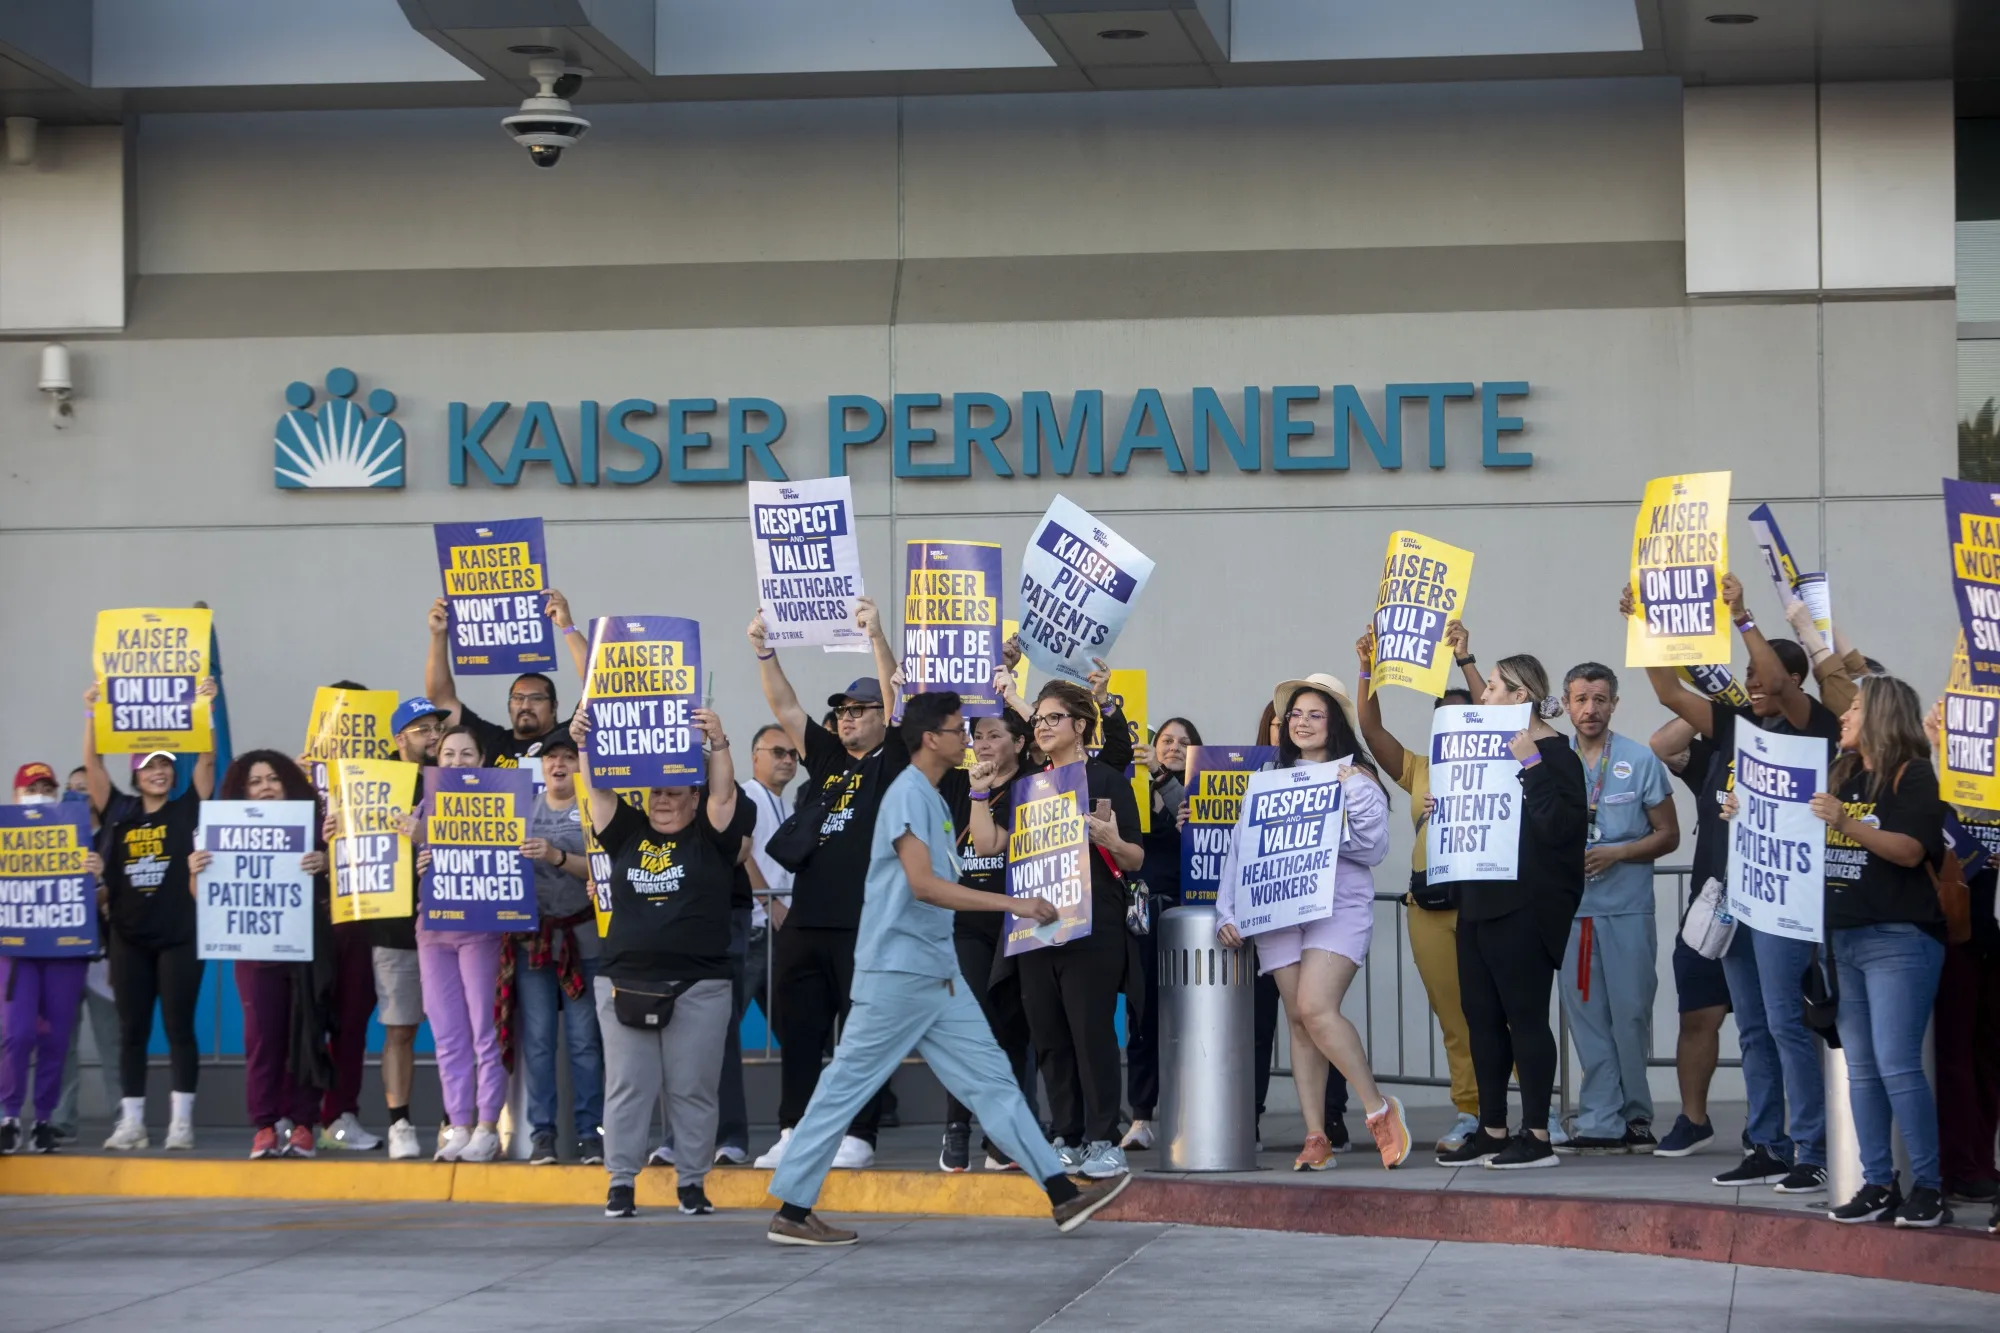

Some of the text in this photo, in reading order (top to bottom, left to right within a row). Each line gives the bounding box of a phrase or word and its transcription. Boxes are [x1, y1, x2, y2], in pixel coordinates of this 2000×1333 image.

[448, 381, 1534, 485] KAISER PERMANENTE
[758, 504, 838, 535] RESPECT
[1650, 501, 1708, 534] KAISER
[790, 535, 804, 543] AND
[1637, 531, 1719, 566] WORKERS
[458, 546, 521, 569] KAISER
[771, 543, 831, 571] VALUE
[1052, 532, 1119, 594] KAISER:
[451, 568, 535, 592] WORKERS
[761, 575, 855, 600] HEALTHCARE
[914, 573, 976, 597] KAISER
[1051, 566, 1096, 609] PUT
[1646, 567, 1708, 601] ON ULP
[1377, 578, 1457, 611] ORKERS
[452, 595, 540, 622] WON'T BE
[773, 599, 848, 622] WORKERS
[908, 597, 989, 622] WORKERS
[1020, 573, 1109, 647] PATIENTS
[1393, 606, 1436, 636] ULP
[1649, 601, 1713, 635] STRIKE
[117, 627, 188, 650] KAISER
[456, 620, 543, 647] SILENCED
[782, 631, 804, 640] STRIKE
[906, 629, 991, 656] WON'T BE
[1021, 609, 1081, 660] FIRST
[102, 650, 201, 674] WORKERS
[605, 645, 674, 669] KAISER
[905, 656, 991, 684] SILENCED
[114, 677, 189, 704] ON ULP
[594, 669, 687, 695] WORKERS
[115, 704, 190, 730] STRIKE
[318, 711, 376, 738] KISER
[593, 699, 689, 728] WON'T BE
[1948, 696, 1994, 734] ON ULP
[596, 727, 690, 756] SILENCED
[1441, 734, 1507, 760] KAISER:
[1948, 733, 1993, 772] STRIKE
[607, 766, 631, 776] STRIKE
[1450, 763, 1488, 791] PUT
[1742, 756, 1798, 798] KAISER:
[334, 782, 391, 807] ISER
[1207, 774, 1250, 796] KAIS
[443, 796, 505, 818] KAISER
[1020, 796, 1070, 830] KAISER
[1195, 799, 1242, 821] WORK
[1255, 783, 1340, 821] RESPECT
[1431, 793, 1511, 826] PATIENTS
[1749, 795, 1779, 833] PUT
[434, 820, 518, 842] WORKERS
[1286, 815, 1301, 823] AND
[3, 829, 69, 851] KAISER
[219, 827, 291, 850] KAISER:
[1013, 819, 1080, 858] WORKERS
[1193, 828, 1233, 854] WON
[1264, 821, 1321, 854] VALUE
[1440, 825, 1491, 855] FIRST
[1736, 821, 1811, 874] PATIENTS
[235, 855, 274, 879] PUT
[431, 849, 522, 875] WON'T BE
[591, 854, 612, 881] ON
[1242, 848, 1332, 886] HEALTHCARE
[1824, 849, 1868, 865] ALTHCARE
[1012, 849, 1081, 893] WON'T BE
[1742, 862, 1789, 905] FIRST
[1825, 863, 1861, 879] ORKERS
[58, 878, 85, 902] BE
[207, 882, 302, 908] PATIENTS
[433, 875, 524, 901] SILENCED
[633, 880, 680, 894] WORKERS
[1186, 891, 1217, 899] ULP STRIK
[1251, 873, 1318, 907] WORKERS
[226, 910, 284, 935] FIRST
[1240, 914, 1271, 929] ULP STRIKE
